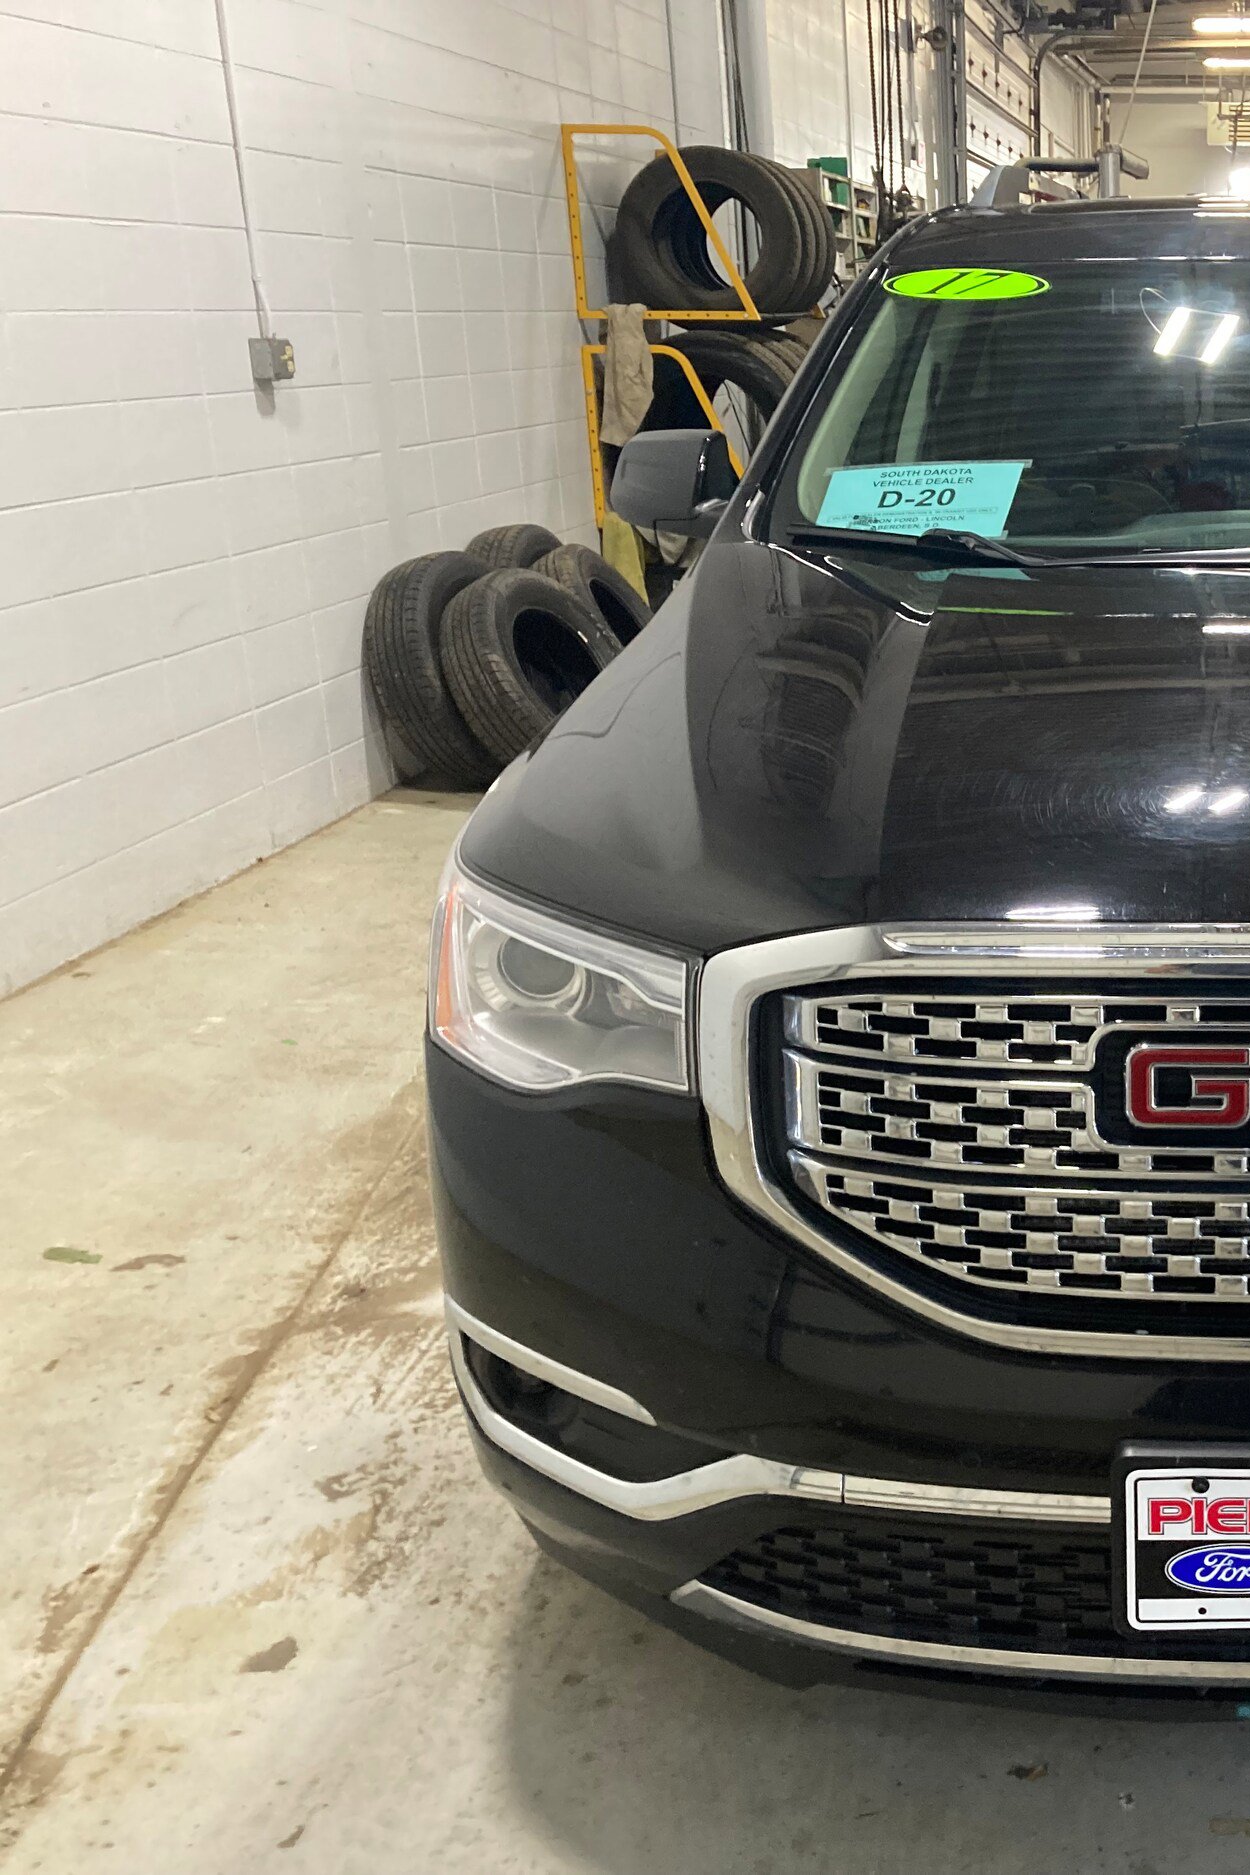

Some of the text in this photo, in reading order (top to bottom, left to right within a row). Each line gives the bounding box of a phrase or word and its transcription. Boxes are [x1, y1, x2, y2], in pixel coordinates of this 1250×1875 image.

[919, 271, 1011, 294] 17
[880, 468, 972, 478] SOUTH DAKOTA
[873, 477, 974, 488] VEHICLE DEALER
[877, 488, 956, 509] D-20
